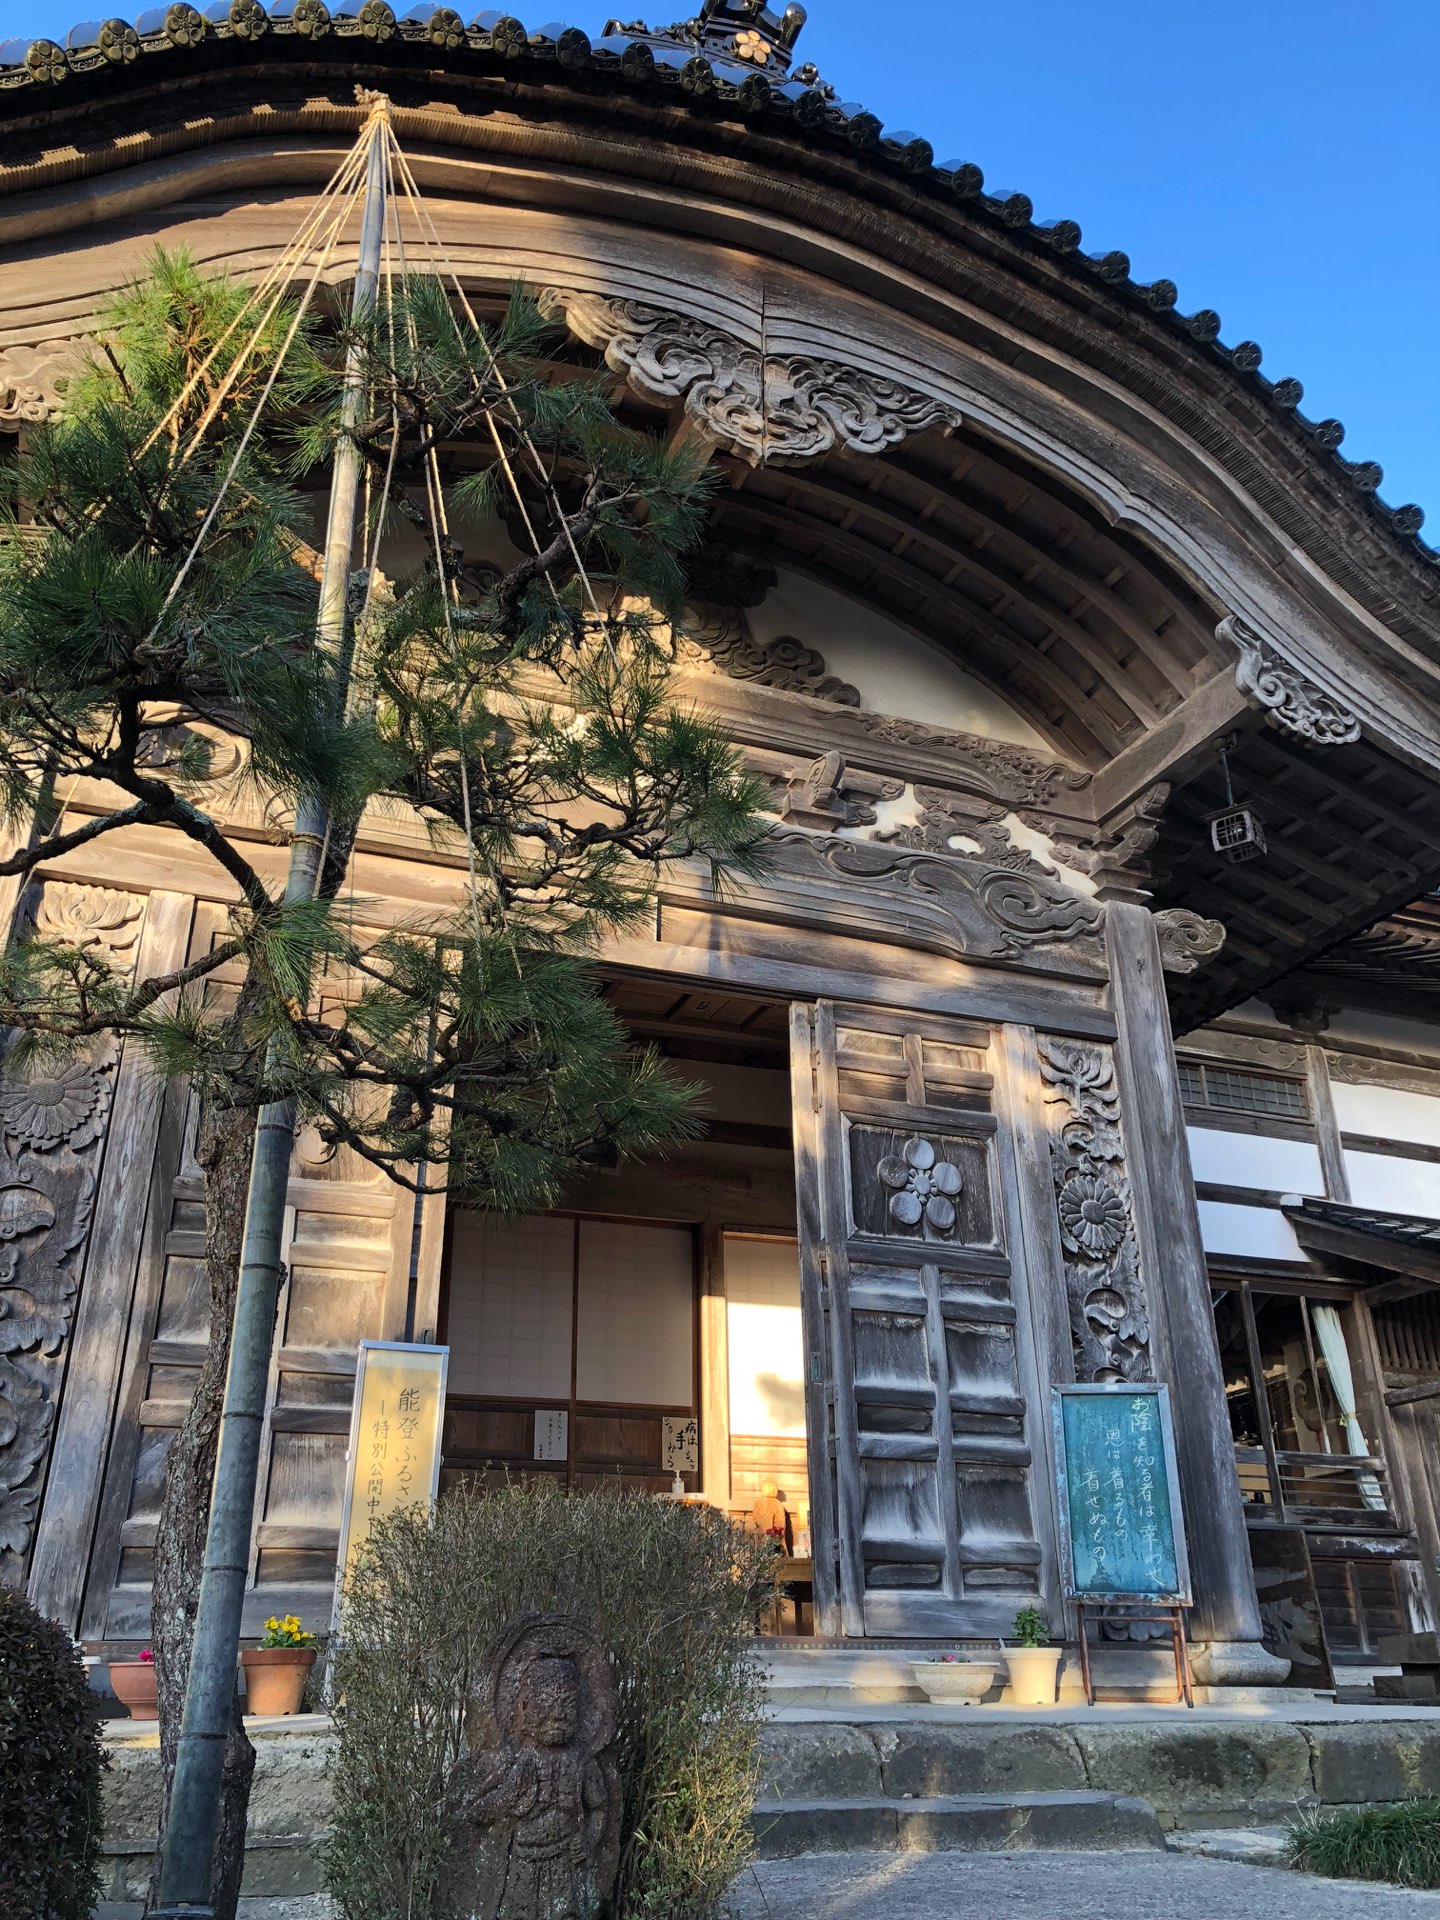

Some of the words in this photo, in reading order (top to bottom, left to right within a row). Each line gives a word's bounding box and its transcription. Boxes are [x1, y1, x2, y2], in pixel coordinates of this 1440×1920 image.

[675, 1429, 686, 1450] 手
[1080, 1467, 1109, 1563] 着せぬもの
